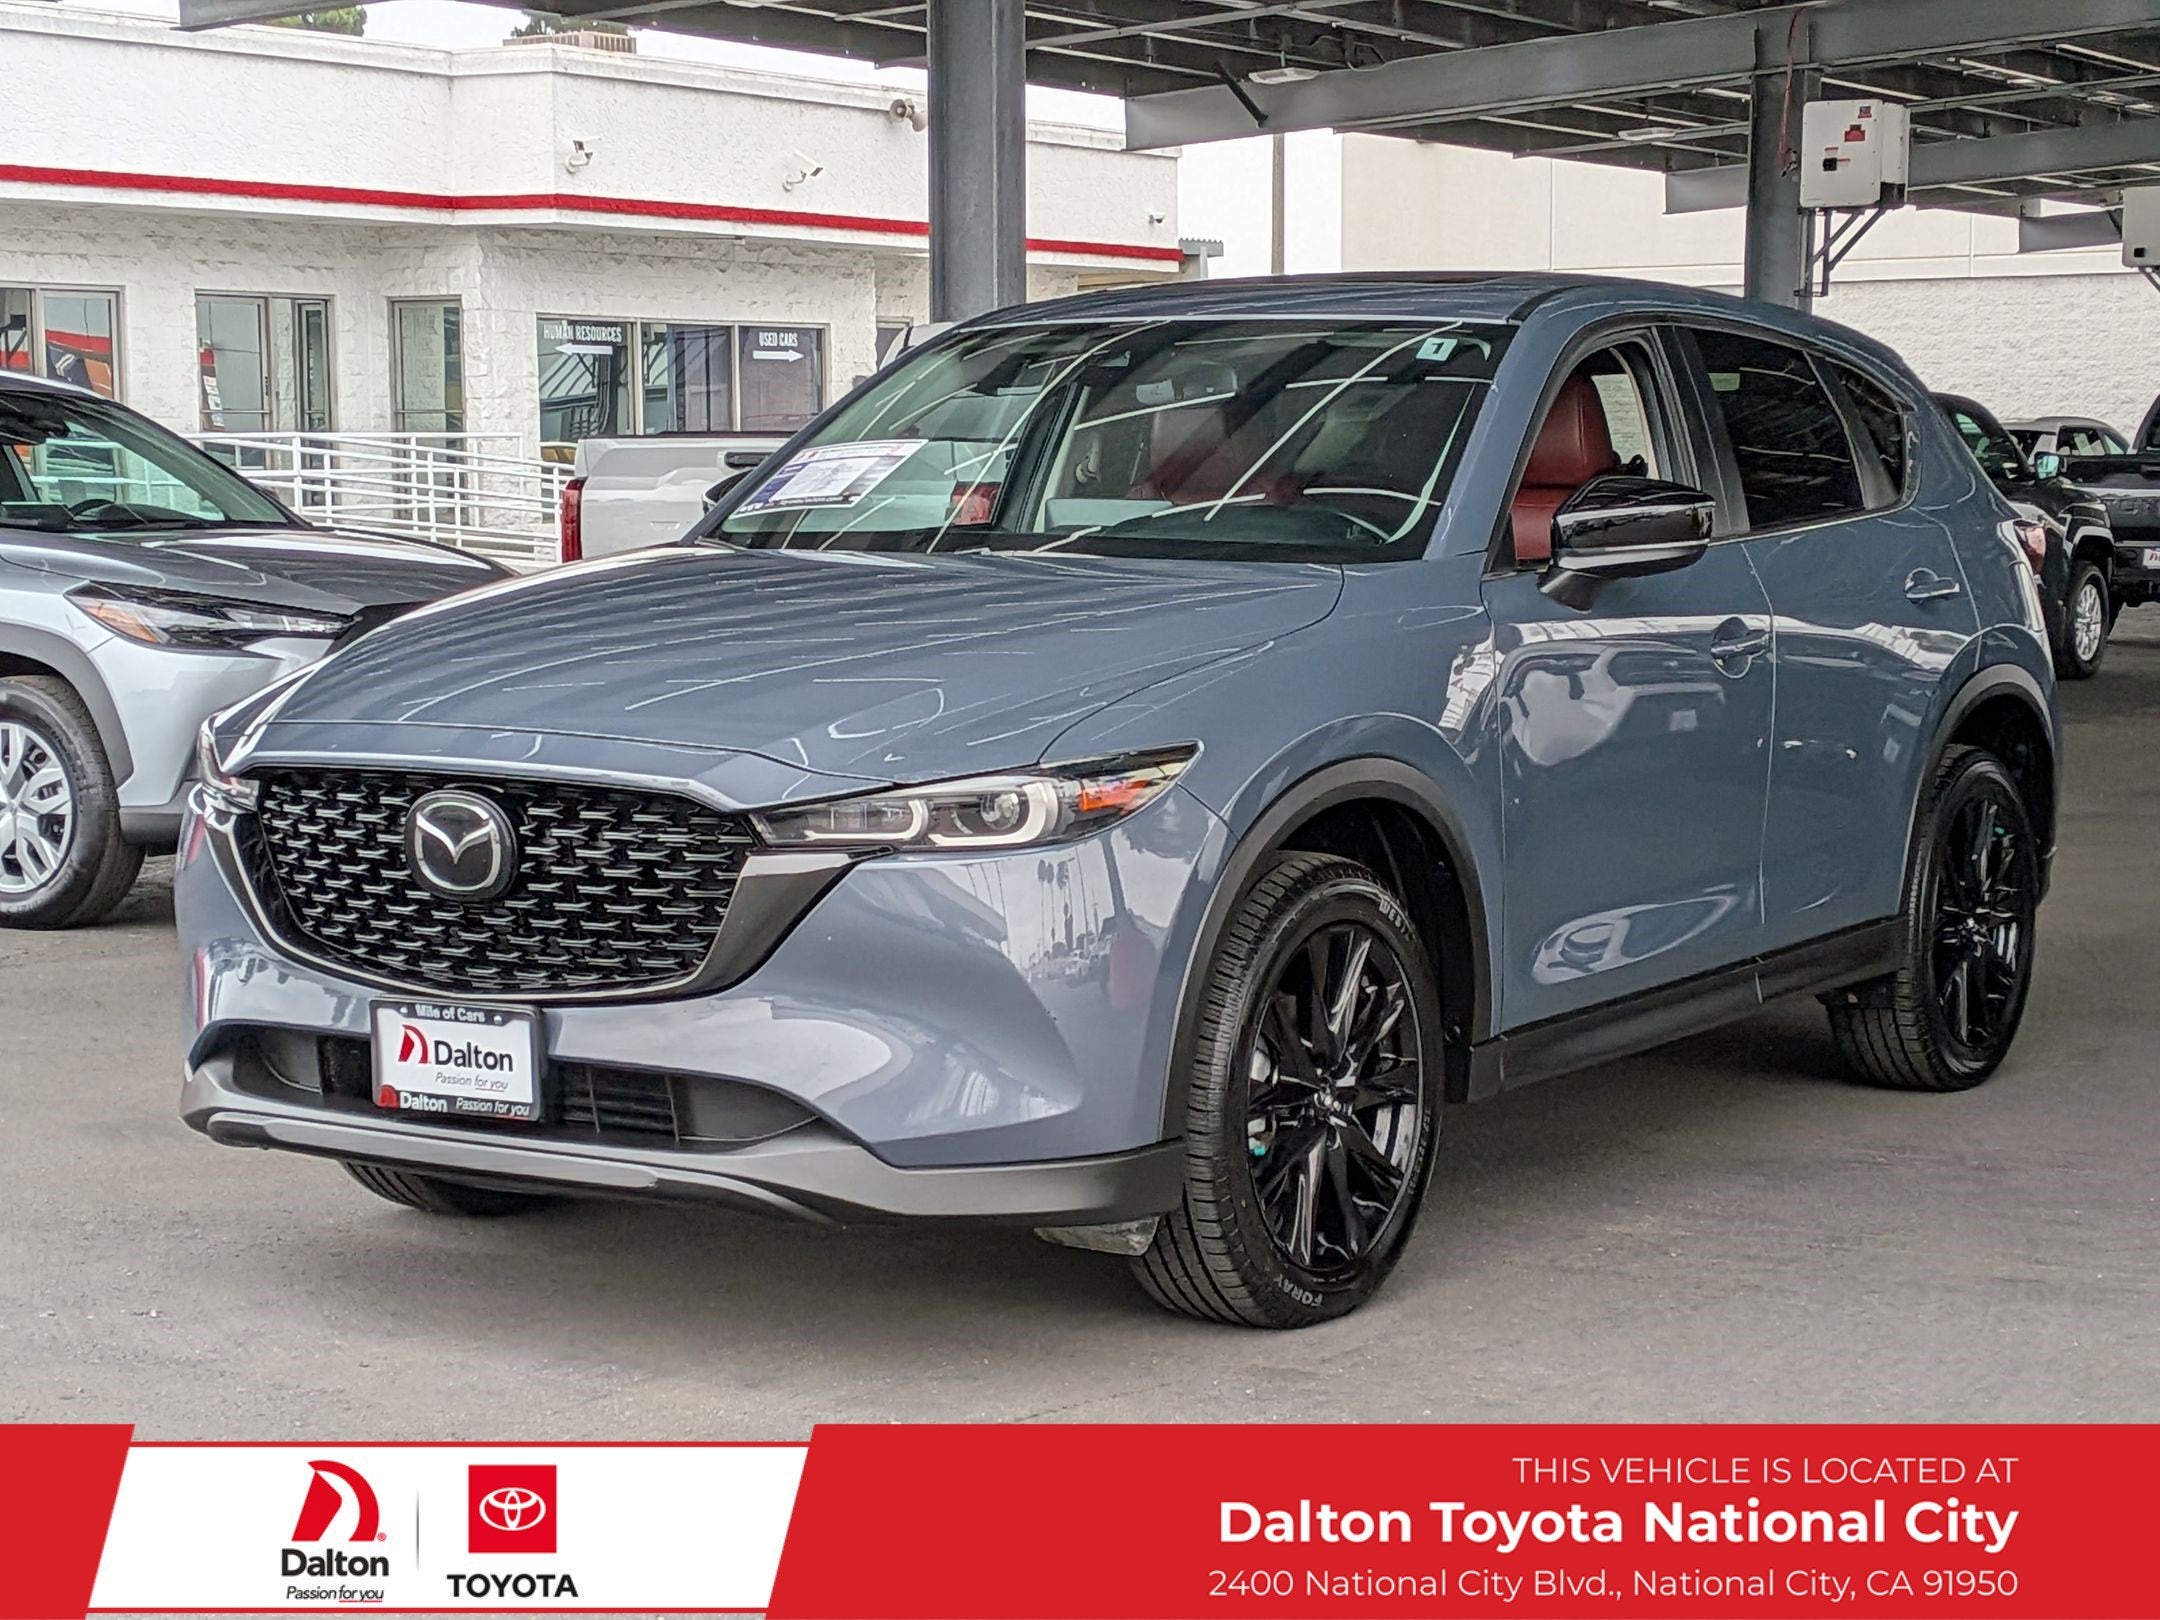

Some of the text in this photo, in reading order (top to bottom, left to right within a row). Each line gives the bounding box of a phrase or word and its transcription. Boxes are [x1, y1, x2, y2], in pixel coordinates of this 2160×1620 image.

[544, 324, 622, 342] HUMAN RESOURCES
[759, 331, 799, 347] USED CARS
[415, 1003, 486, 1022] Mile of Cars
[433, 1040, 514, 1073] Dalton
[435, 1072, 509, 1090] Passion for you
[400, 1091, 530, 1116] Dalton Passion for you
